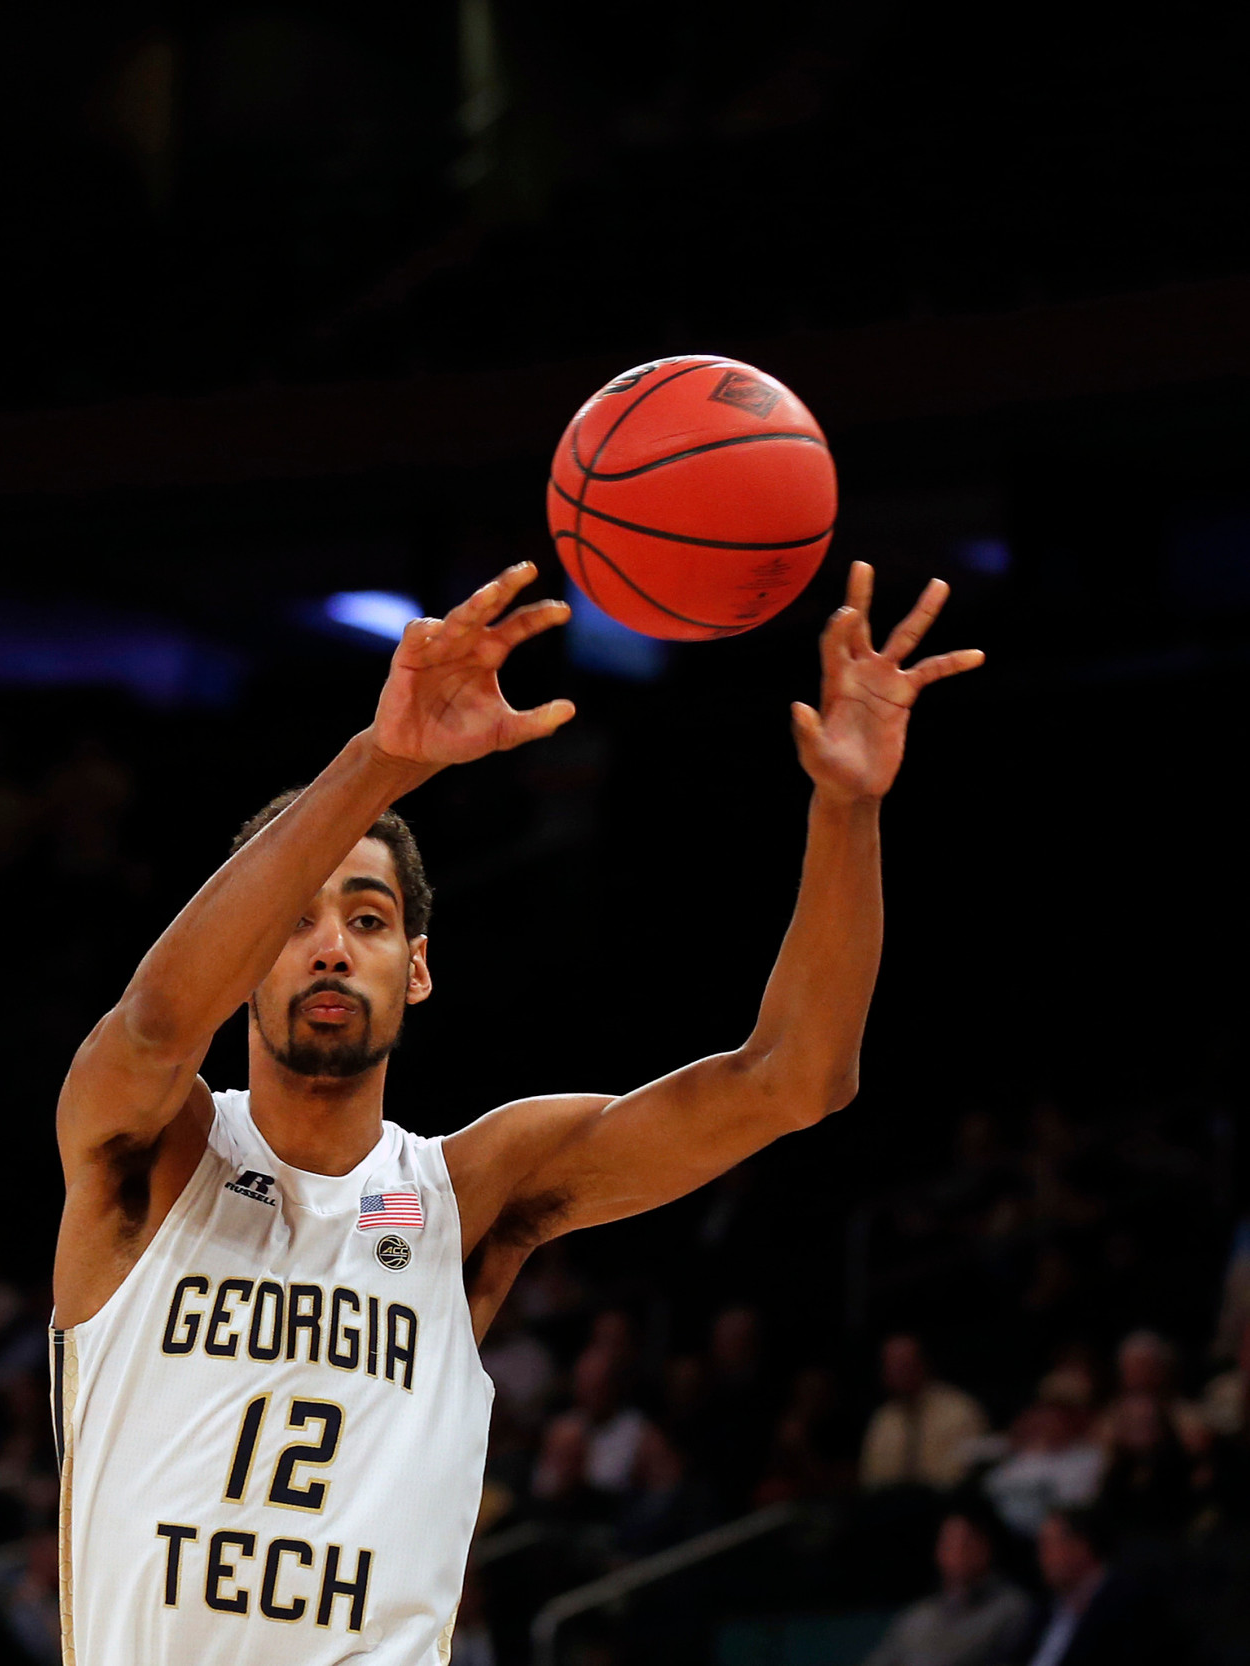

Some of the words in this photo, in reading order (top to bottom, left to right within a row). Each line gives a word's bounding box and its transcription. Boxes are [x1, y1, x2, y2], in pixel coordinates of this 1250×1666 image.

[224, 1181, 277, 1207] RUSSELL
[381, 1246, 410, 1257] ACC
[161, 1274, 419, 1394] GEORGIA
[220, 1391, 346, 1515] 12
[155, 1520, 375, 1634] TECH
